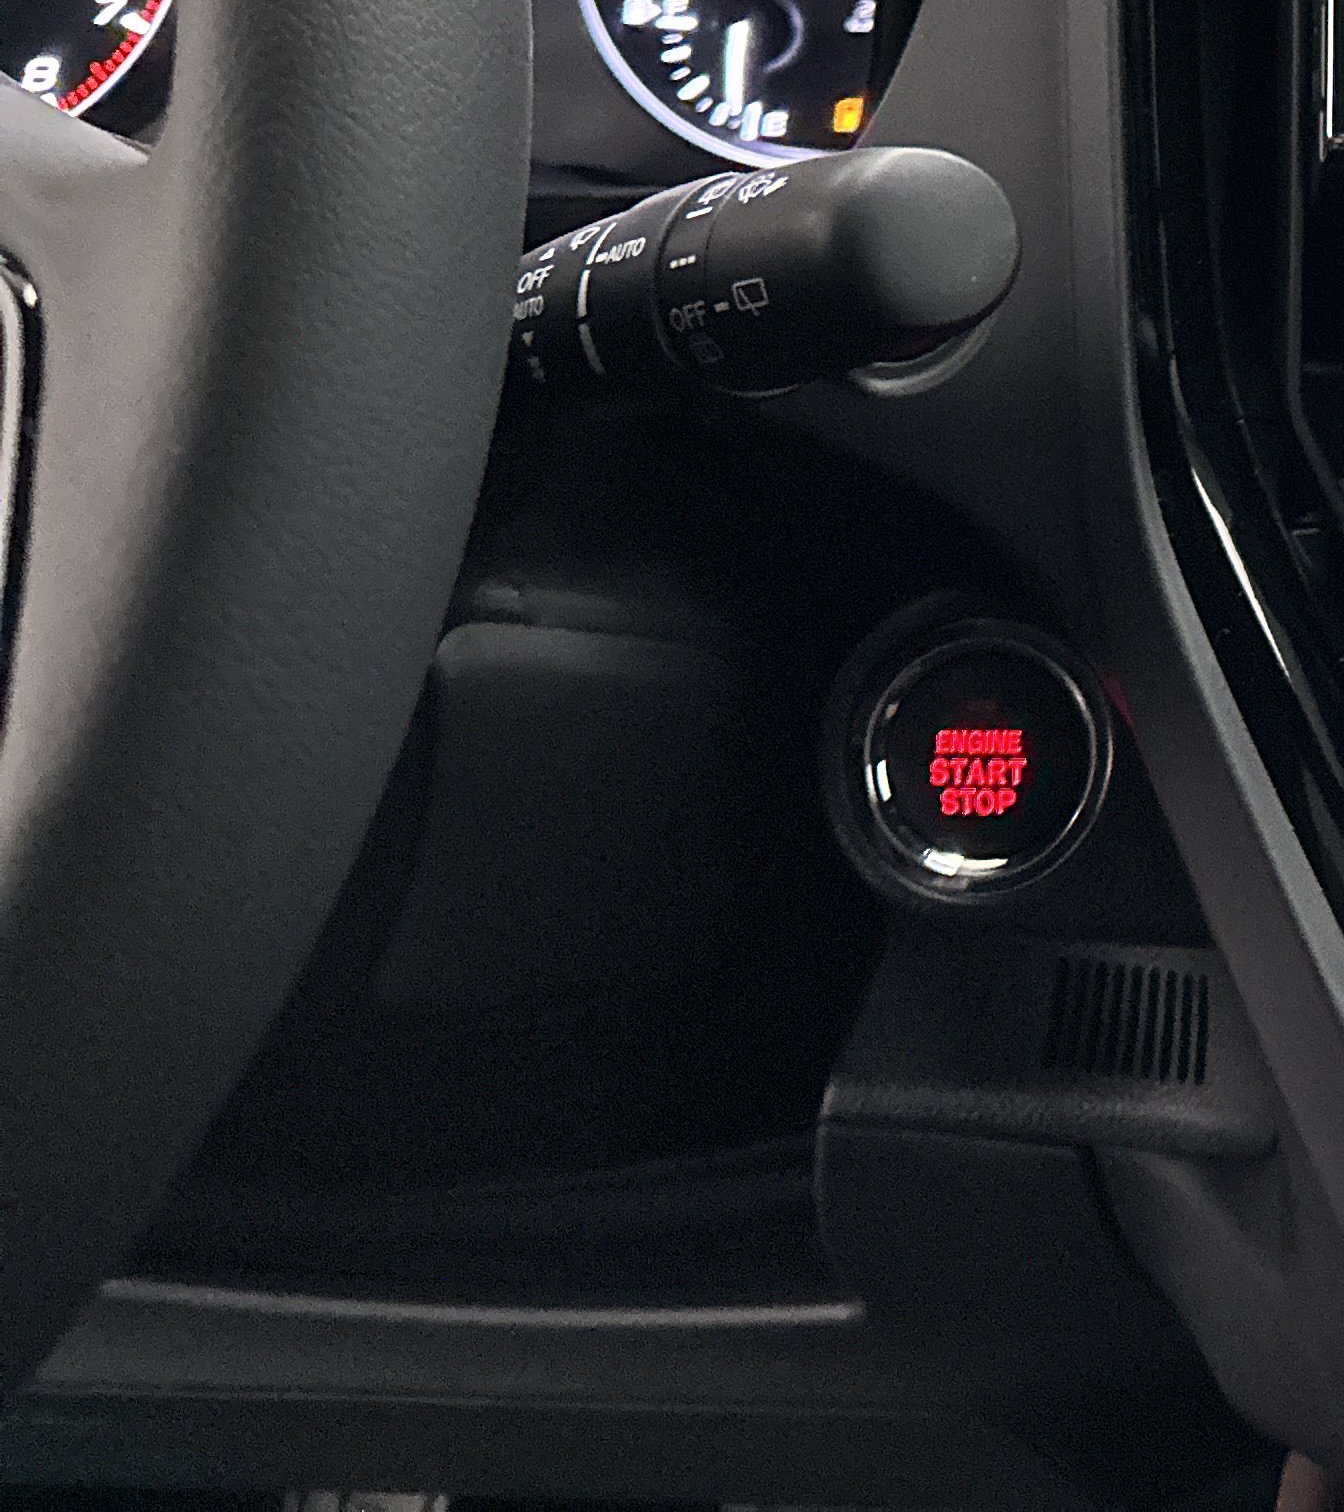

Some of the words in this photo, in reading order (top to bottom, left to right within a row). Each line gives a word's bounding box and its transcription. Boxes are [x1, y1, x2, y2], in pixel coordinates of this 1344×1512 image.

[21, 56, 61, 93] 8
[605, 237, 646, 264] AUTO
[517, 264, 554, 294] OFF
[669, 300, 706, 333] OFF
[934, 729, 1023, 755] ENGINE
[929, 757, 1027, 787] START
[939, 787, 1017, 816] STOP
